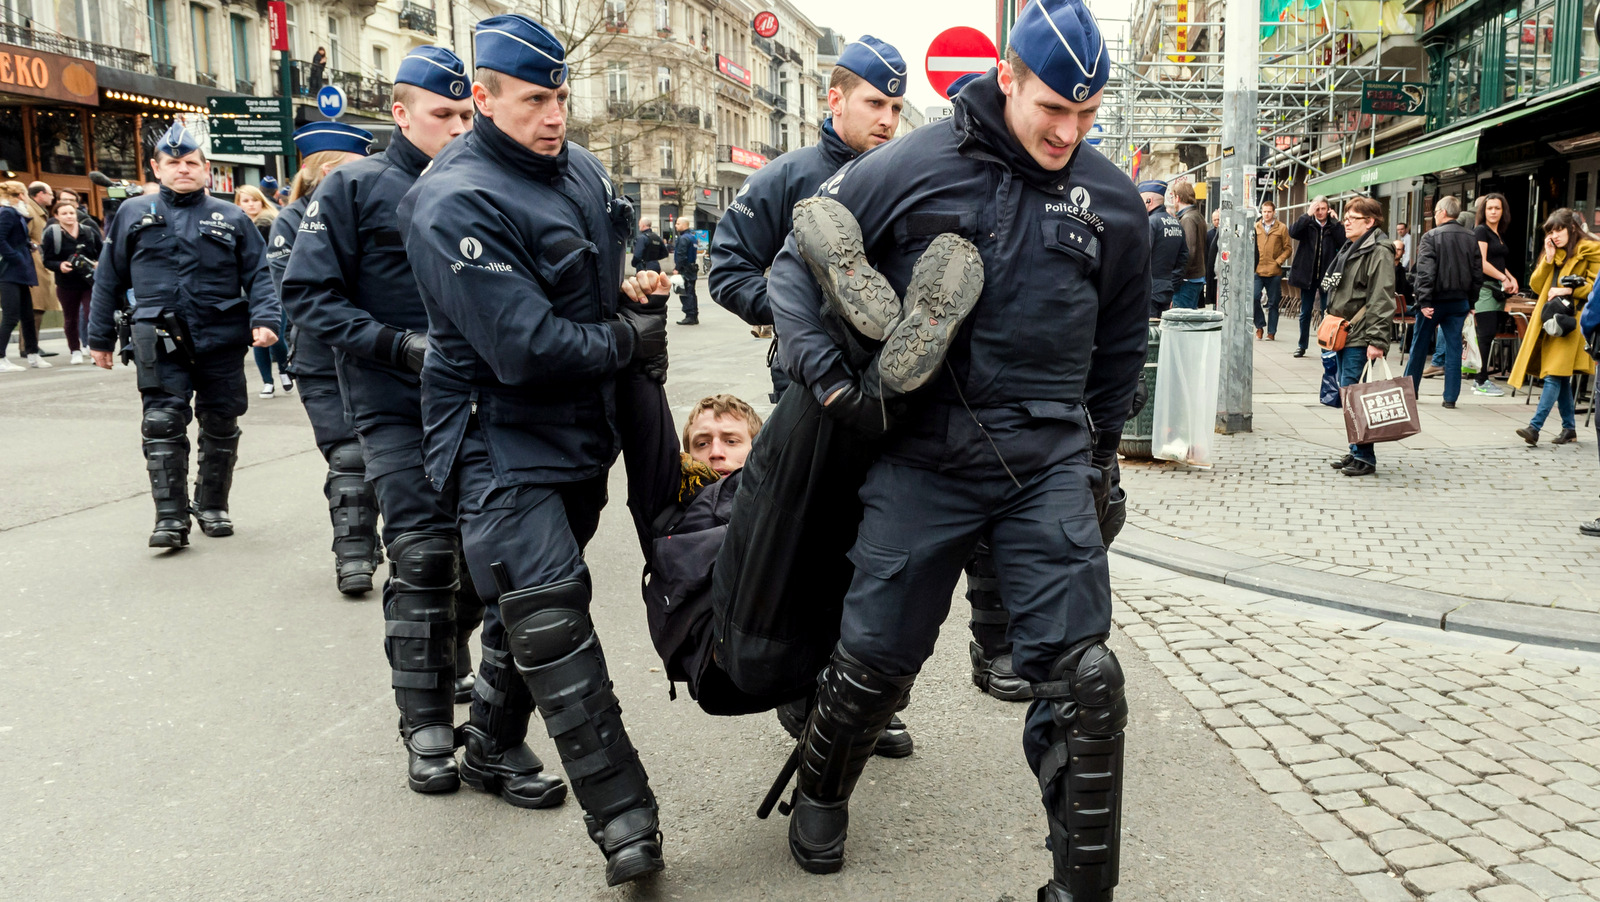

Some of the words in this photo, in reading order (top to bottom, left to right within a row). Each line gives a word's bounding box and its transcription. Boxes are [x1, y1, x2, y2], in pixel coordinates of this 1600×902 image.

[757, 16, 775, 31] AB
[320, 95, 340, 108] M
[1367, 90, 1393, 99] FISH
[1372, 102, 1407, 111] CHIPS
[1370, 168, 1379, 181] pub
[731, 200, 755, 219] Politie
[1045, 203, 1079, 215] Police
[1079, 208, 1105, 233] Politie
[1164, 226, 1182, 238] Politie
[1366, 393, 1402, 410] PÊLE
[1369, 408, 1406, 424] MÊLE
